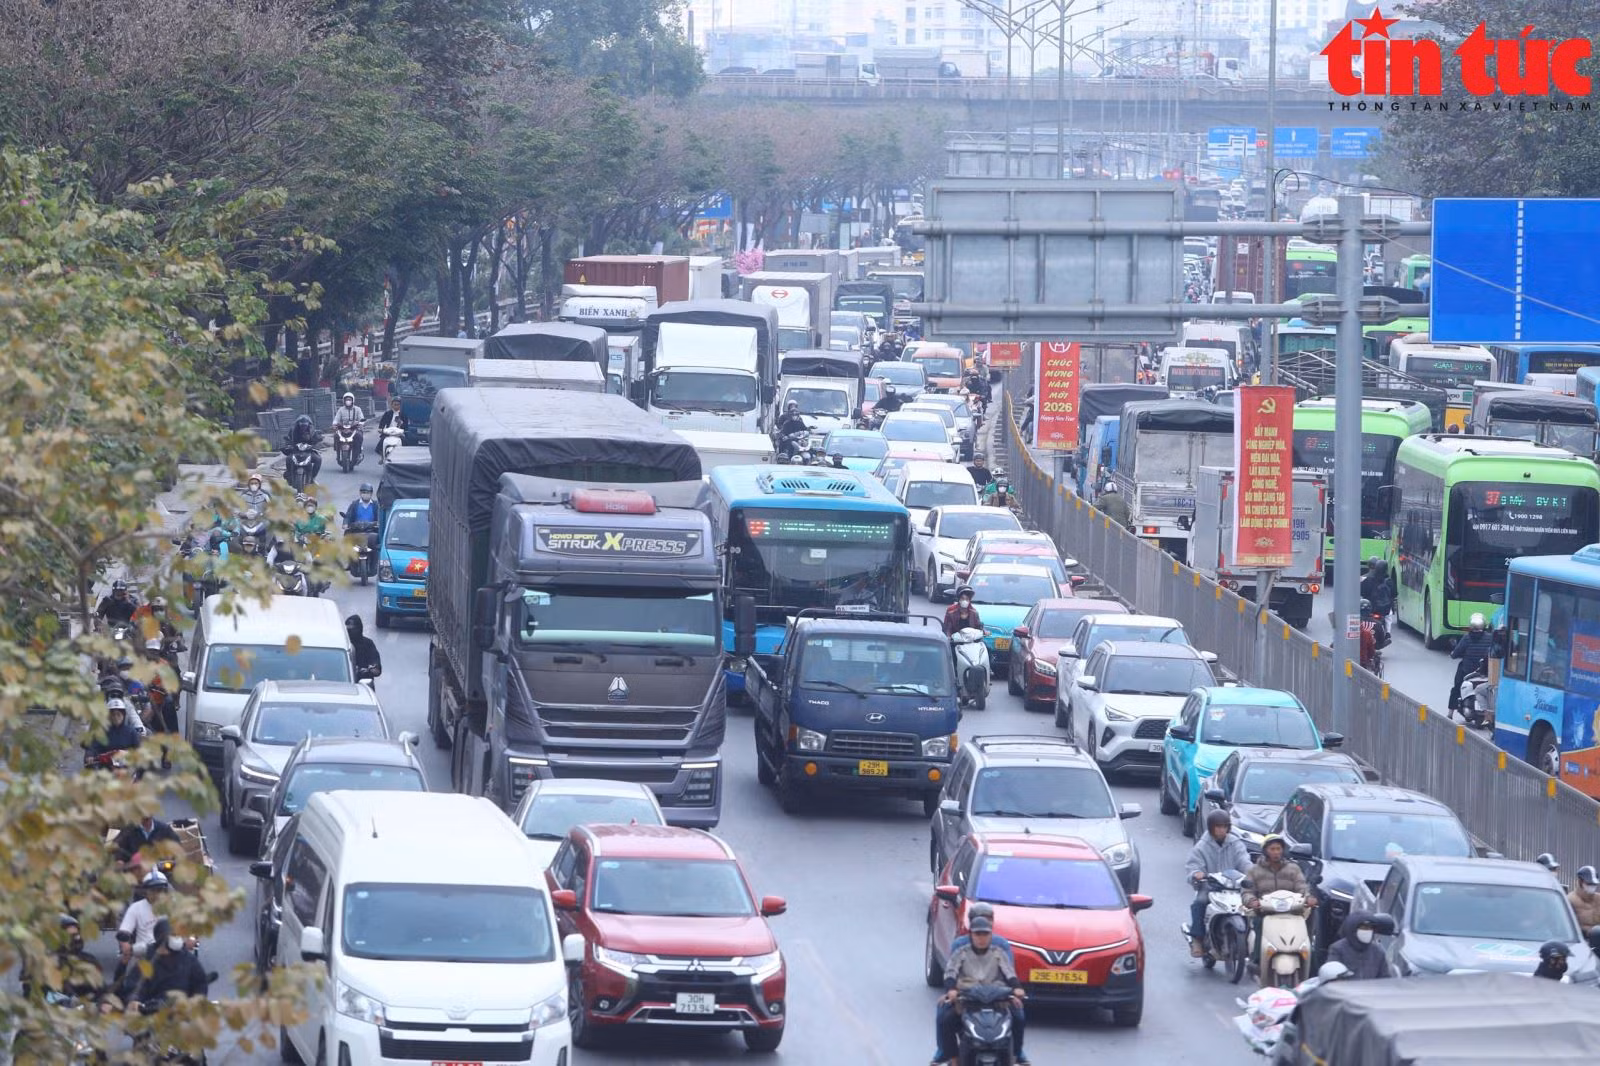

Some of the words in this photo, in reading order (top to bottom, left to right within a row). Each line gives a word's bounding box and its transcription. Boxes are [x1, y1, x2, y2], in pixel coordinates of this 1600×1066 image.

[603, 308, 628, 317] XANH
[1043, 402, 1073, 412] 2026
[548, 539, 601, 549] SITRUK
[687, 994, 705, 1003] 30H
